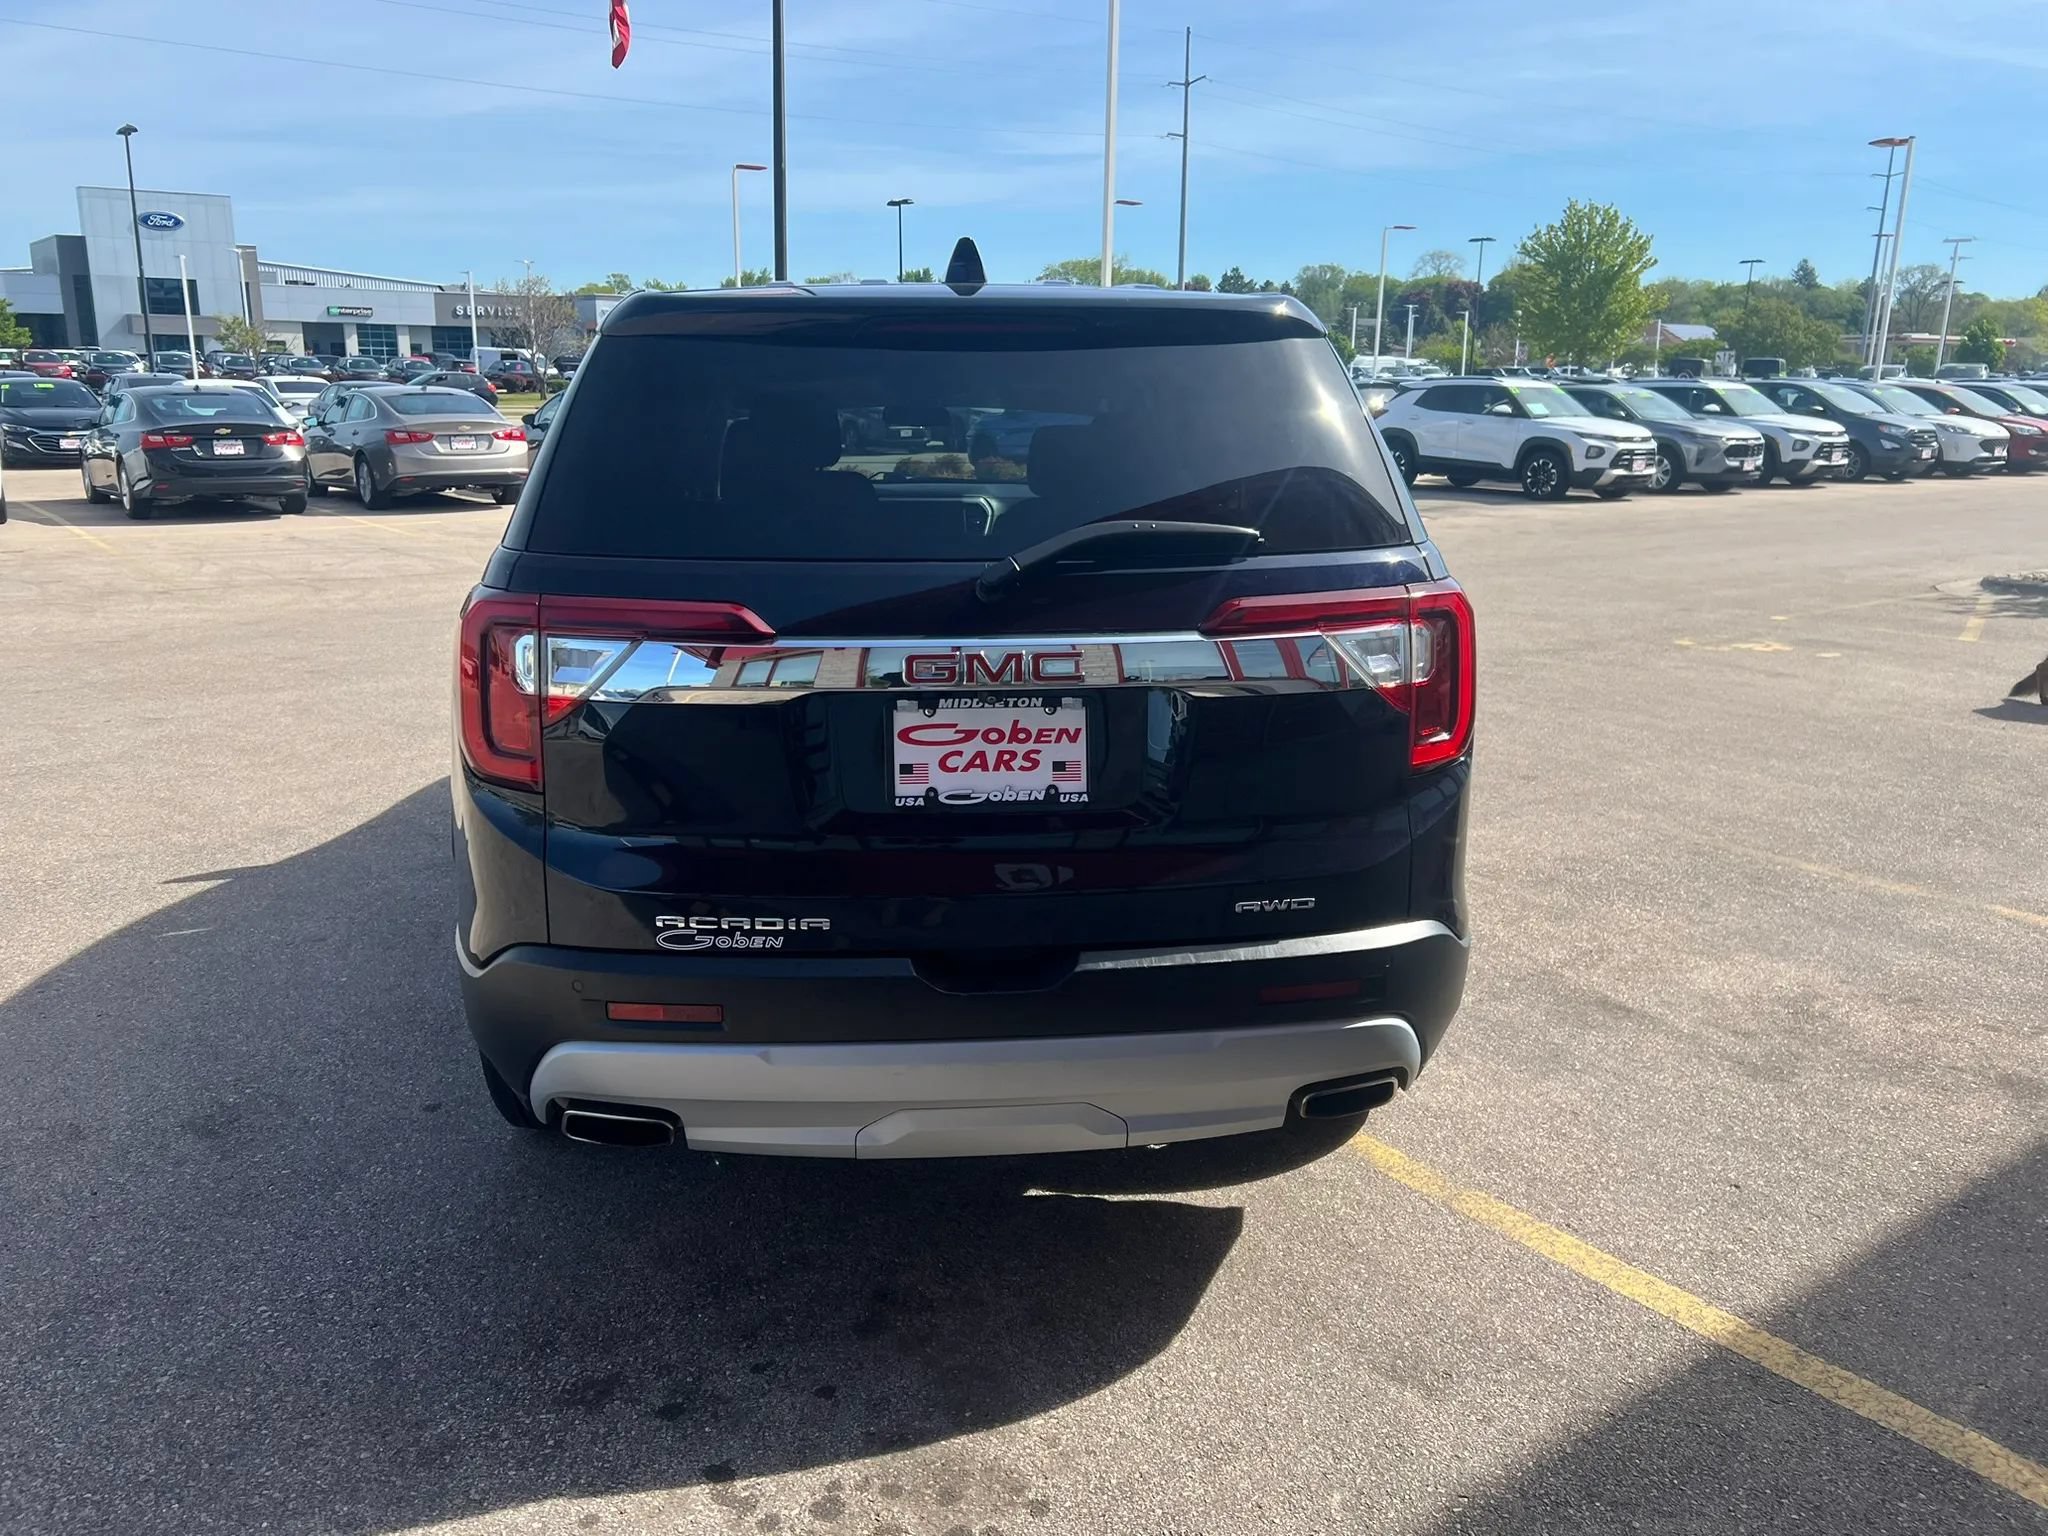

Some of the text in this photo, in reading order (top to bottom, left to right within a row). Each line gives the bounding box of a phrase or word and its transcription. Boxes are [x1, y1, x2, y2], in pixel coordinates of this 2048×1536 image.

[147, 214, 175, 227] Ford
[455, 304, 523, 317] SERVICE
[903, 650, 1085, 686] GMC
[938, 749, 1042, 773] CARS
[895, 797, 925, 807] USA
[1059, 792, 1089, 803] USA
[1235, 897, 1316, 913] AWD
[655, 915, 831, 930] ACADIA
